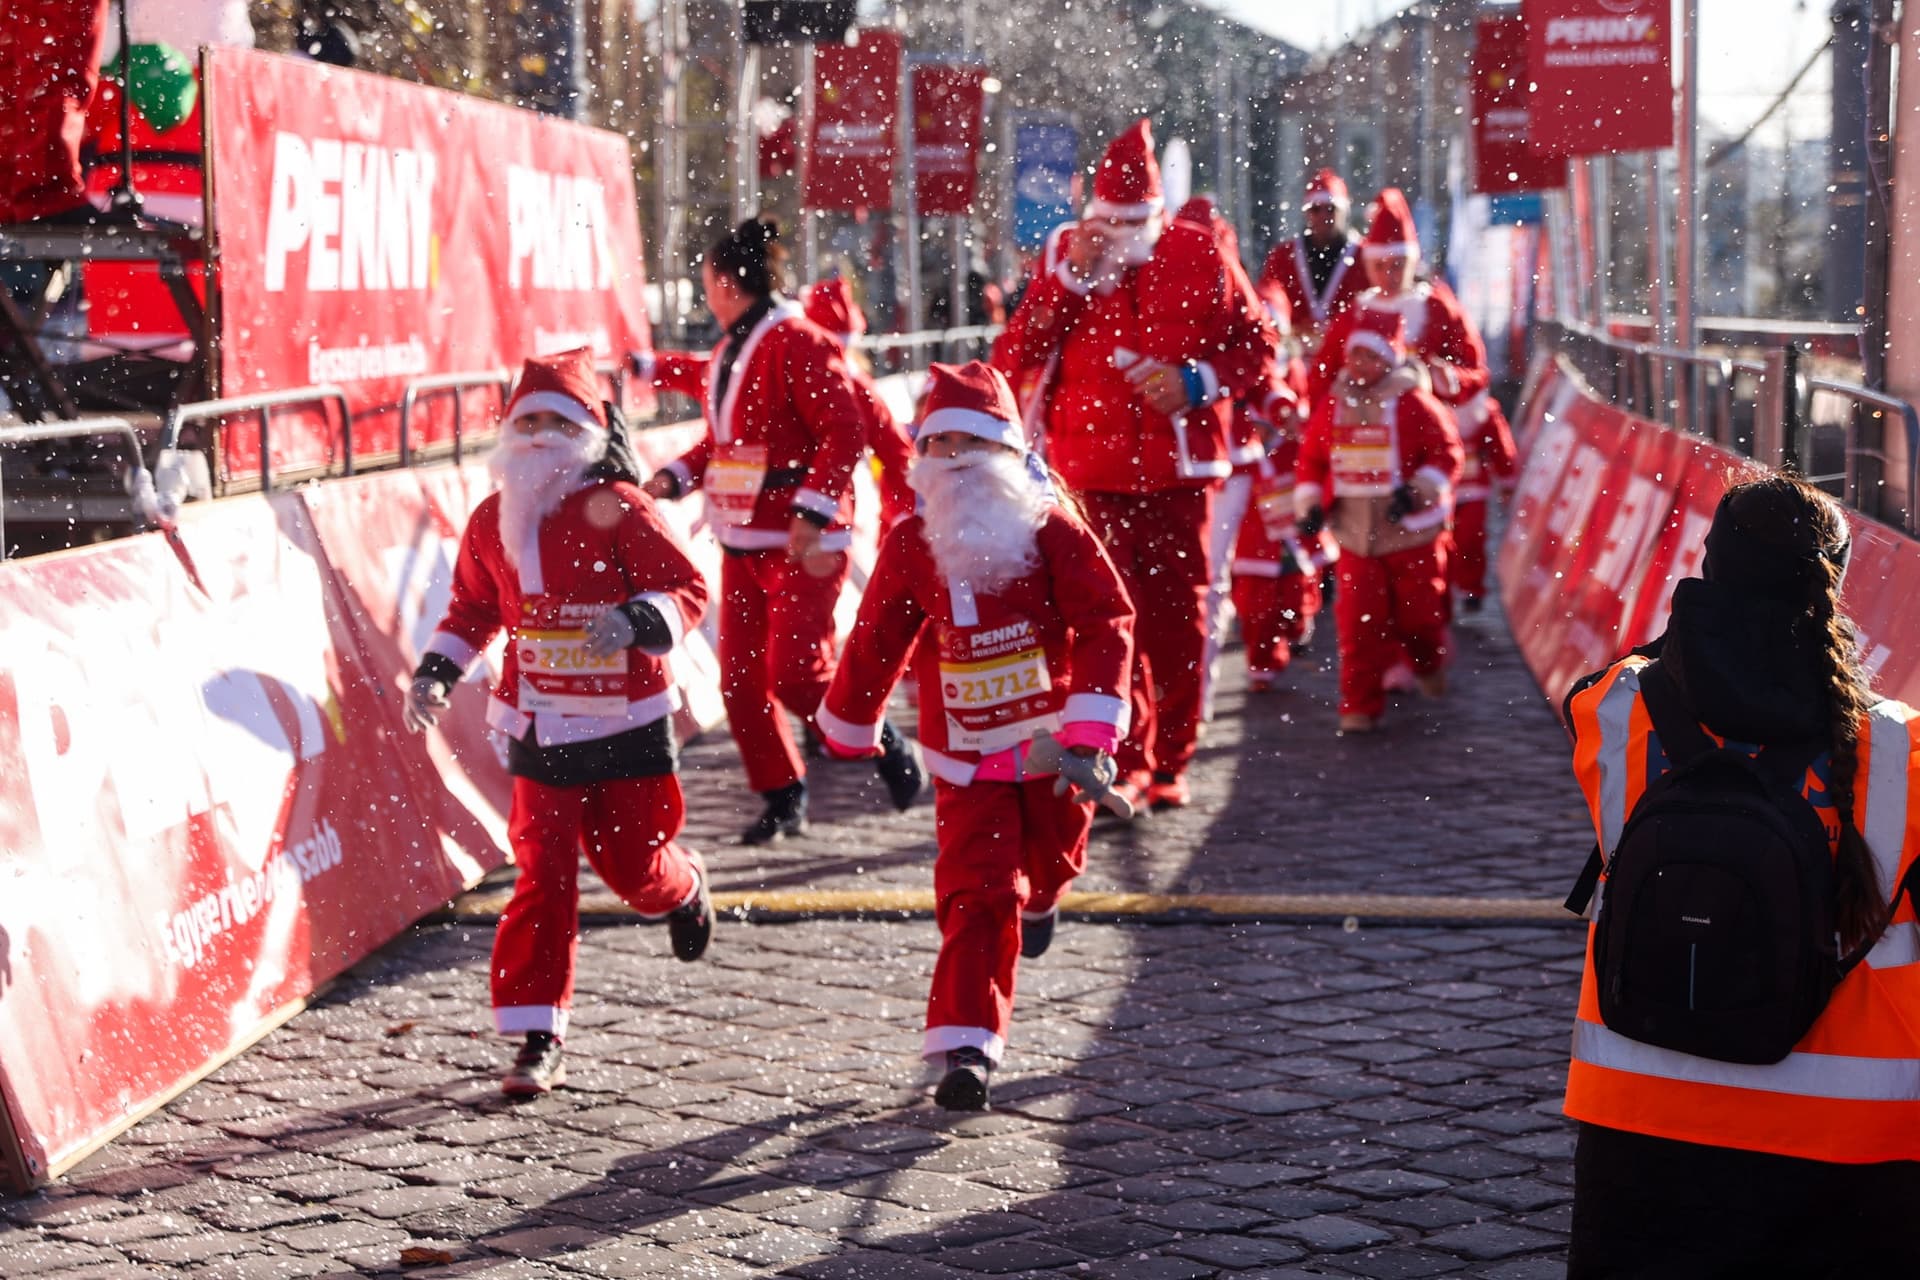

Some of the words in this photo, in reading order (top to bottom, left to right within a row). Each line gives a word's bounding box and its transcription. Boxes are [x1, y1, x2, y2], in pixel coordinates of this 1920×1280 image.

[1544, 15, 1652, 45] PENNY
[265, 131, 437, 291] PENNY
[970, 620, 1029, 648] PENNY
[962, 667, 1040, 703] 21712
